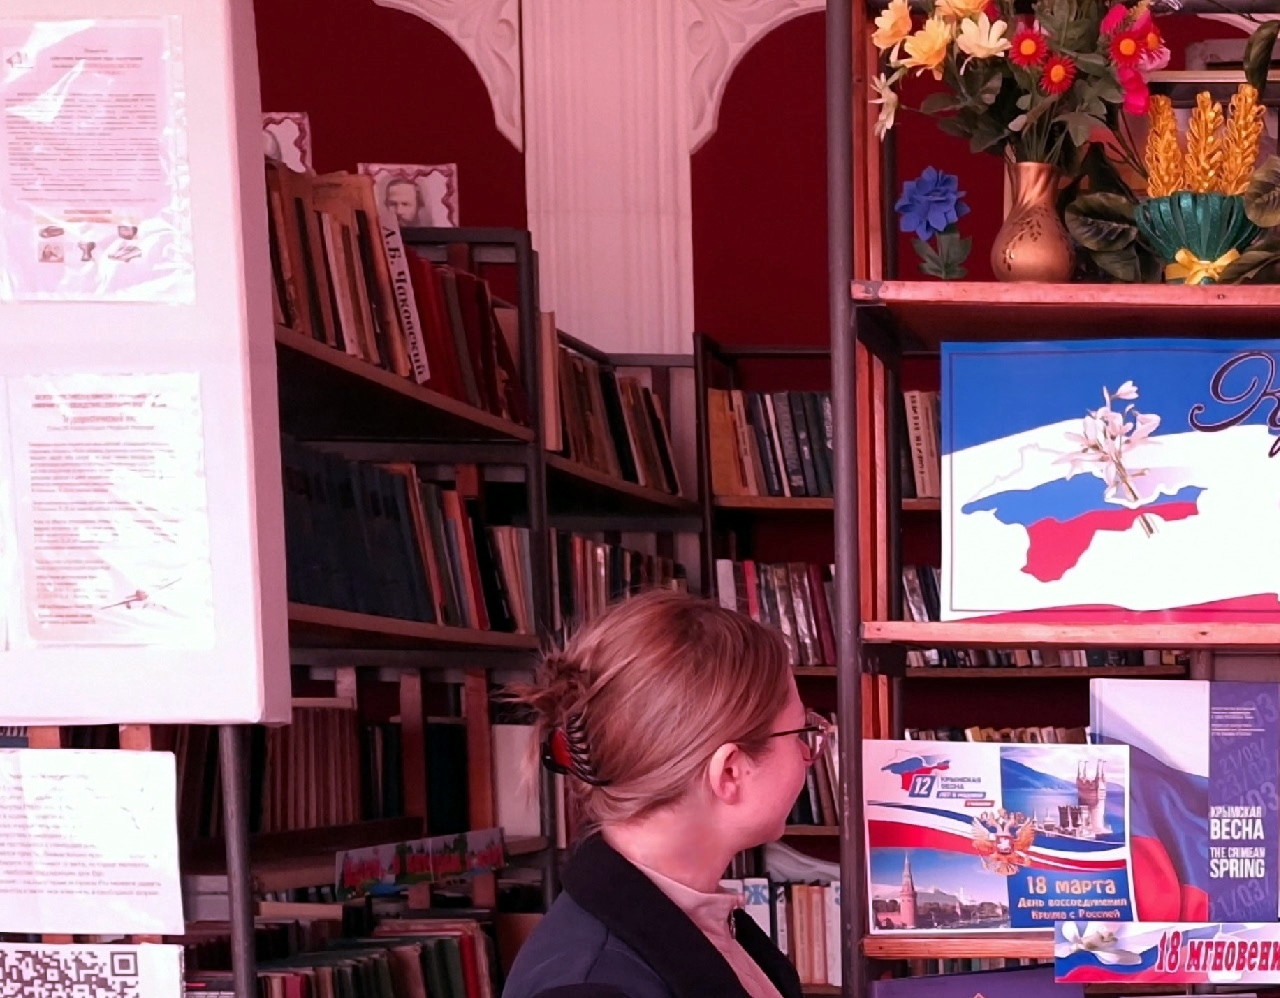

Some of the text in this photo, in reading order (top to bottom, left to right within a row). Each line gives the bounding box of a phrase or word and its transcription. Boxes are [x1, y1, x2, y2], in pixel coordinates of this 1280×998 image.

[913, 776, 931, 795] 12
[1210, 806, 1262, 818] КРЫМСКАЯ
[1210, 819, 1265, 840] ВЕСНА
[1210, 847, 1266, 858] THE CRIMEAN
[1209, 858, 1265, 878] SPRING
[1026, 876, 1117, 896] 18 марта
[1018, 898, 1045, 908] День
[1078, 908, 1121, 920] Россией
[1154, 930, 1180, 973] 18
